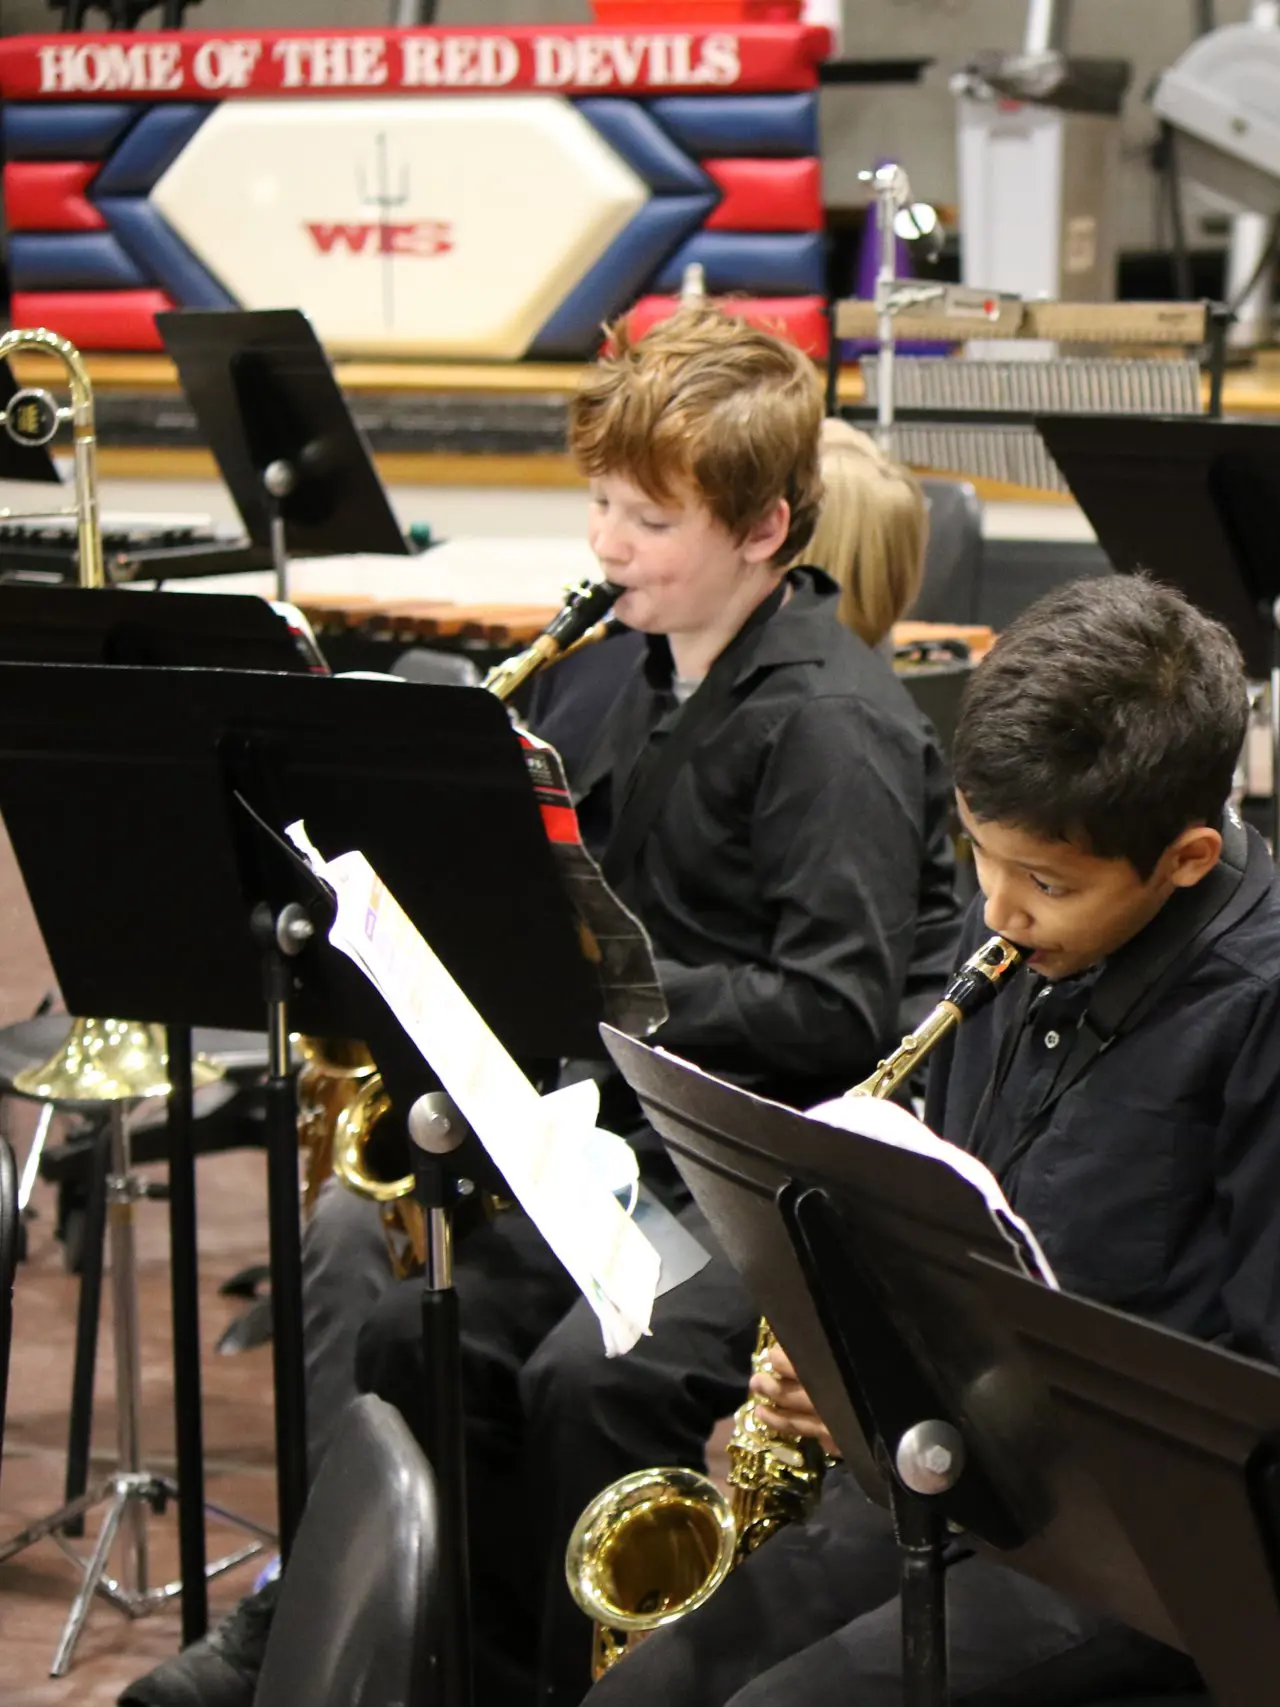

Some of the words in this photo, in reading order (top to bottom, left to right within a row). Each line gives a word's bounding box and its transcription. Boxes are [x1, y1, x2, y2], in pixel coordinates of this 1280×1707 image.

[36, 42, 184, 92] HOME
[193, 38, 262, 89] OF
[272, 36, 389, 87] THE
[400, 35, 520, 86] RED
[532, 32, 742, 86] DEVILS
